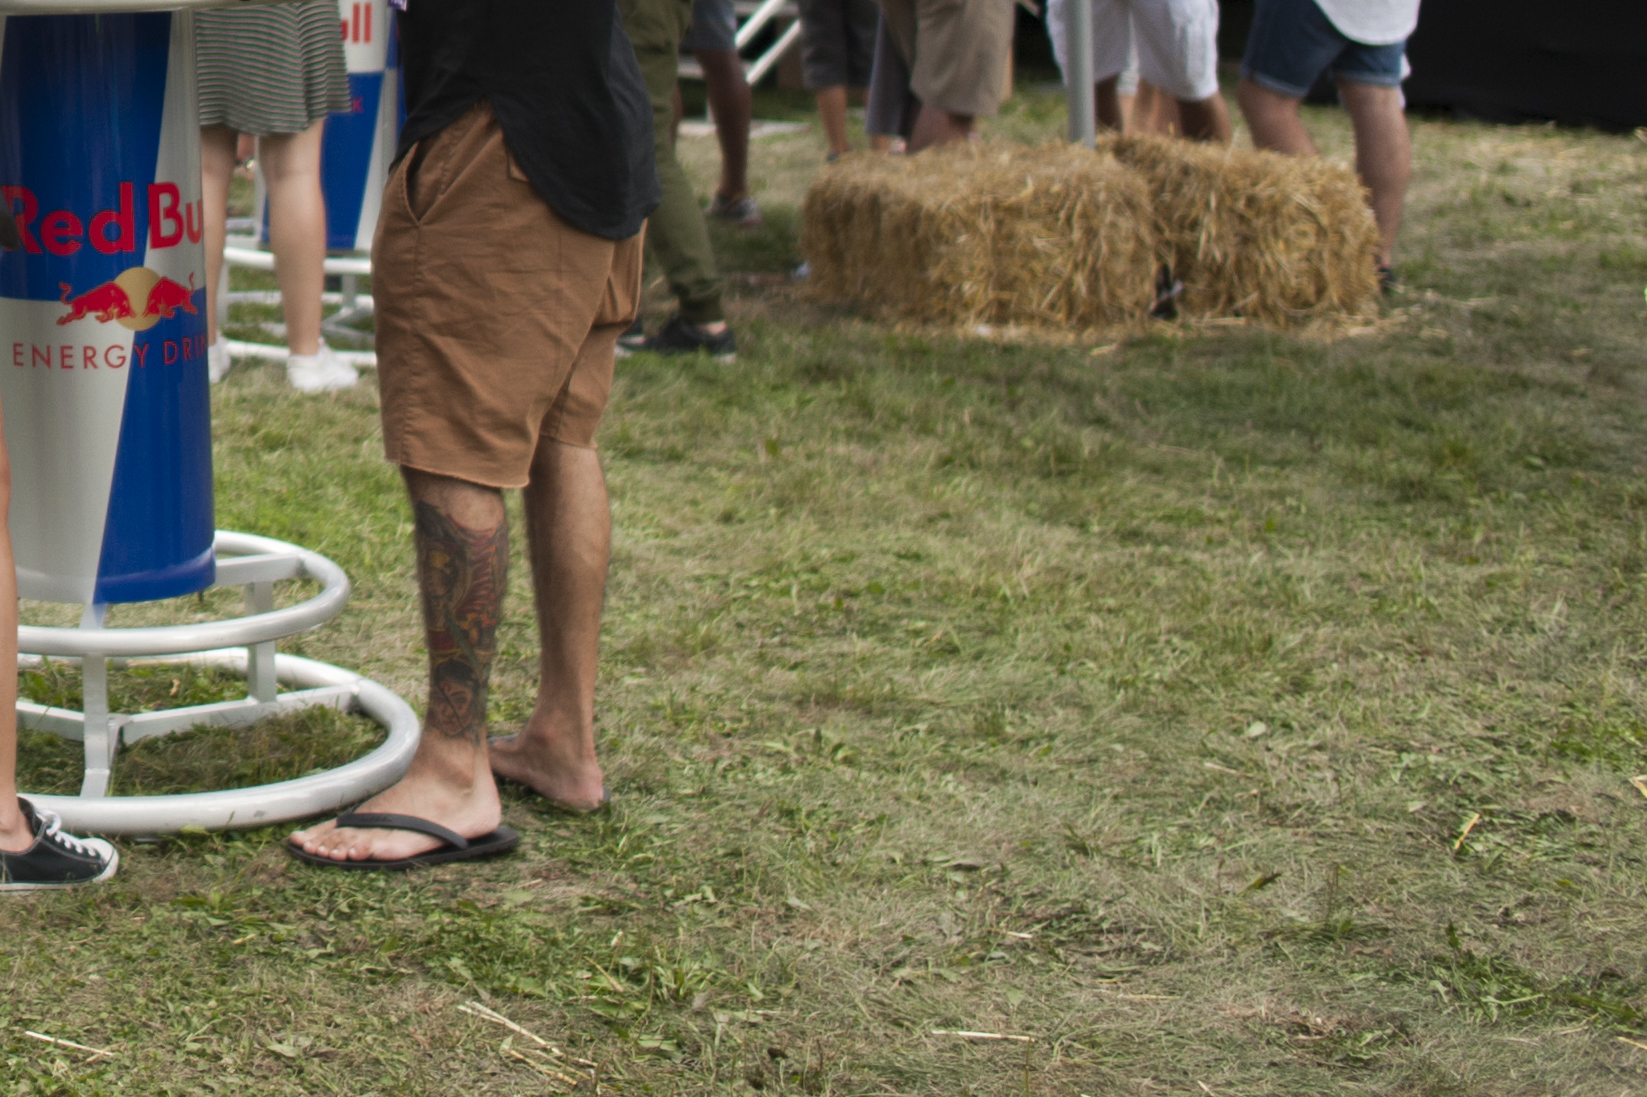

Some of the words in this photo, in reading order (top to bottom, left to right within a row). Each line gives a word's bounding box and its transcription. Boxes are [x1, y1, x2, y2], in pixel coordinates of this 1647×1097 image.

[1, 181, 136, 256] Red
[148, 181, 203, 250] Bu
[12, 342, 150, 370] ENERGY
